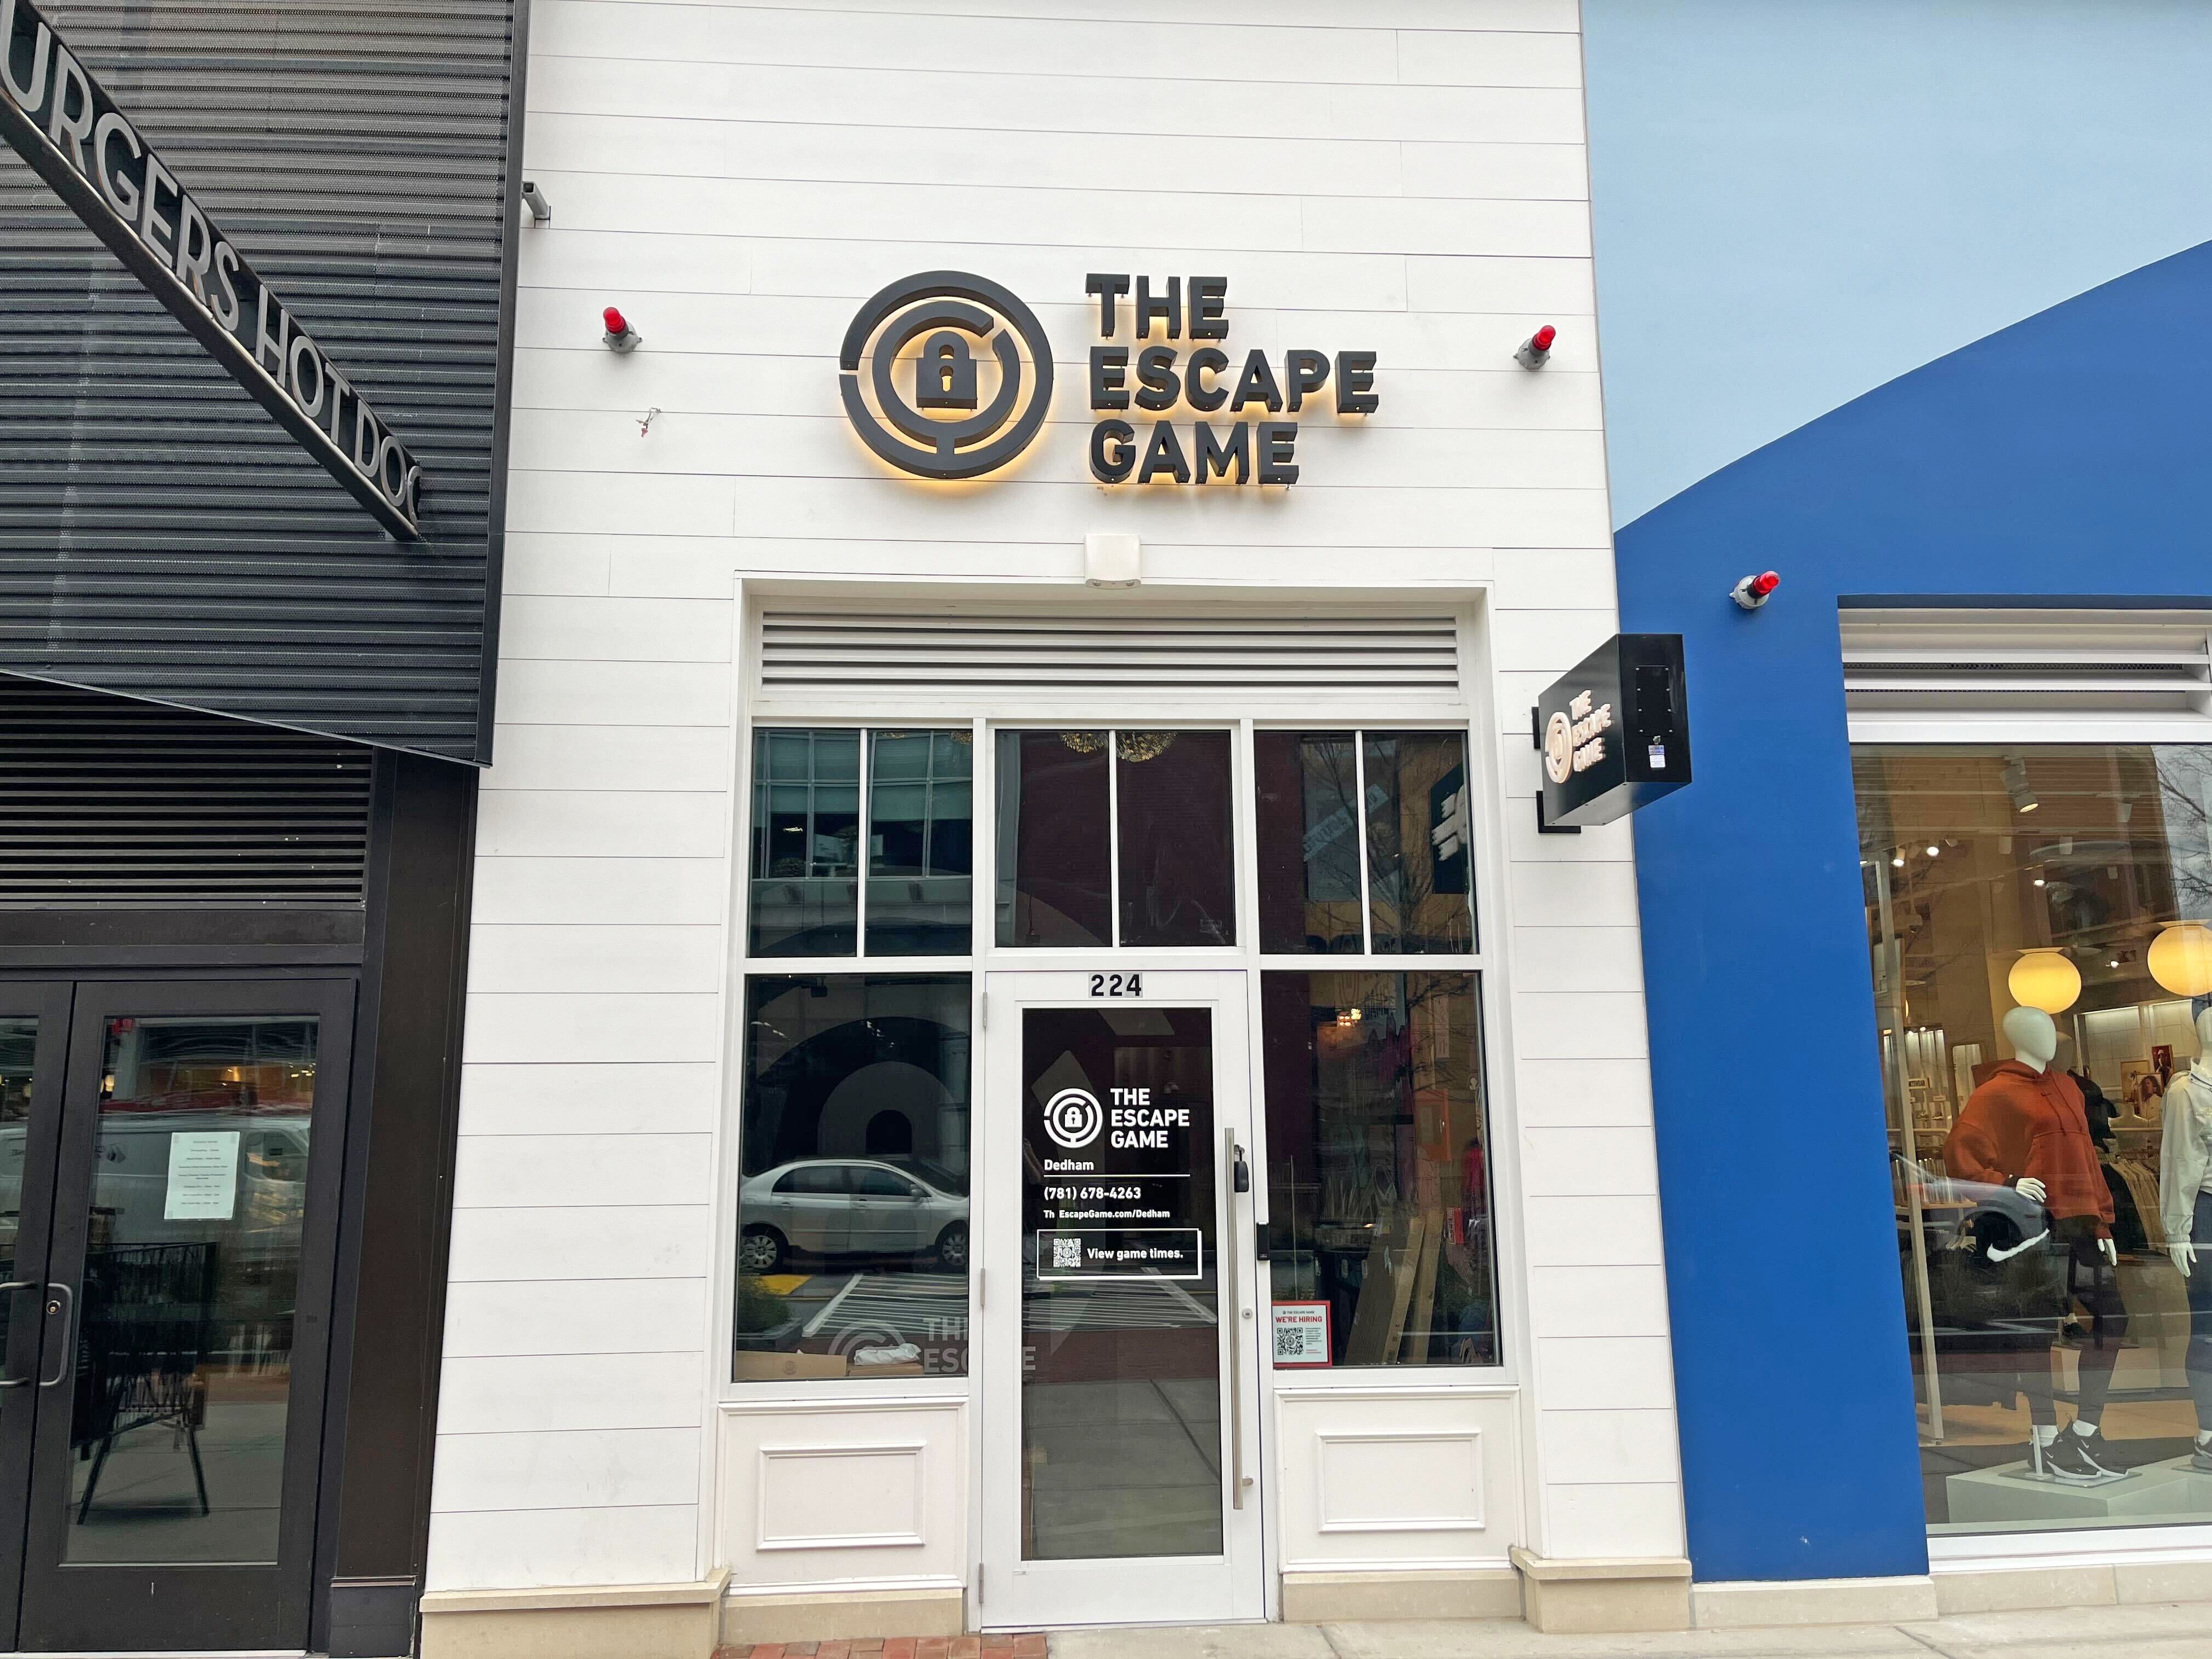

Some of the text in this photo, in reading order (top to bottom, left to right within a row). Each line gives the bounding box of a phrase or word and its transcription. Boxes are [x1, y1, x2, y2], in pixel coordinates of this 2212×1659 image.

[1085, 273, 1229, 339] THE
[256, 284, 350, 445] HOT
[1090, 346, 1379, 415] ESCAPE
[1089, 419, 1300, 485] GAME
[1090, 974, 1142, 997] 224
[1110, 1088, 1150, 1105] THE
[1110, 1109, 1190, 1127] ESCAPE
[1110, 1130, 1169, 1148] GAME
[1044, 1159, 1094, 1170] Dedham
[1044, 1187, 1142, 1200] (781) 678-4263
[1059, 1209, 1170, 1220] EscapeGame.com/Dedham
[1087, 1248, 1183, 1261] View game times.
